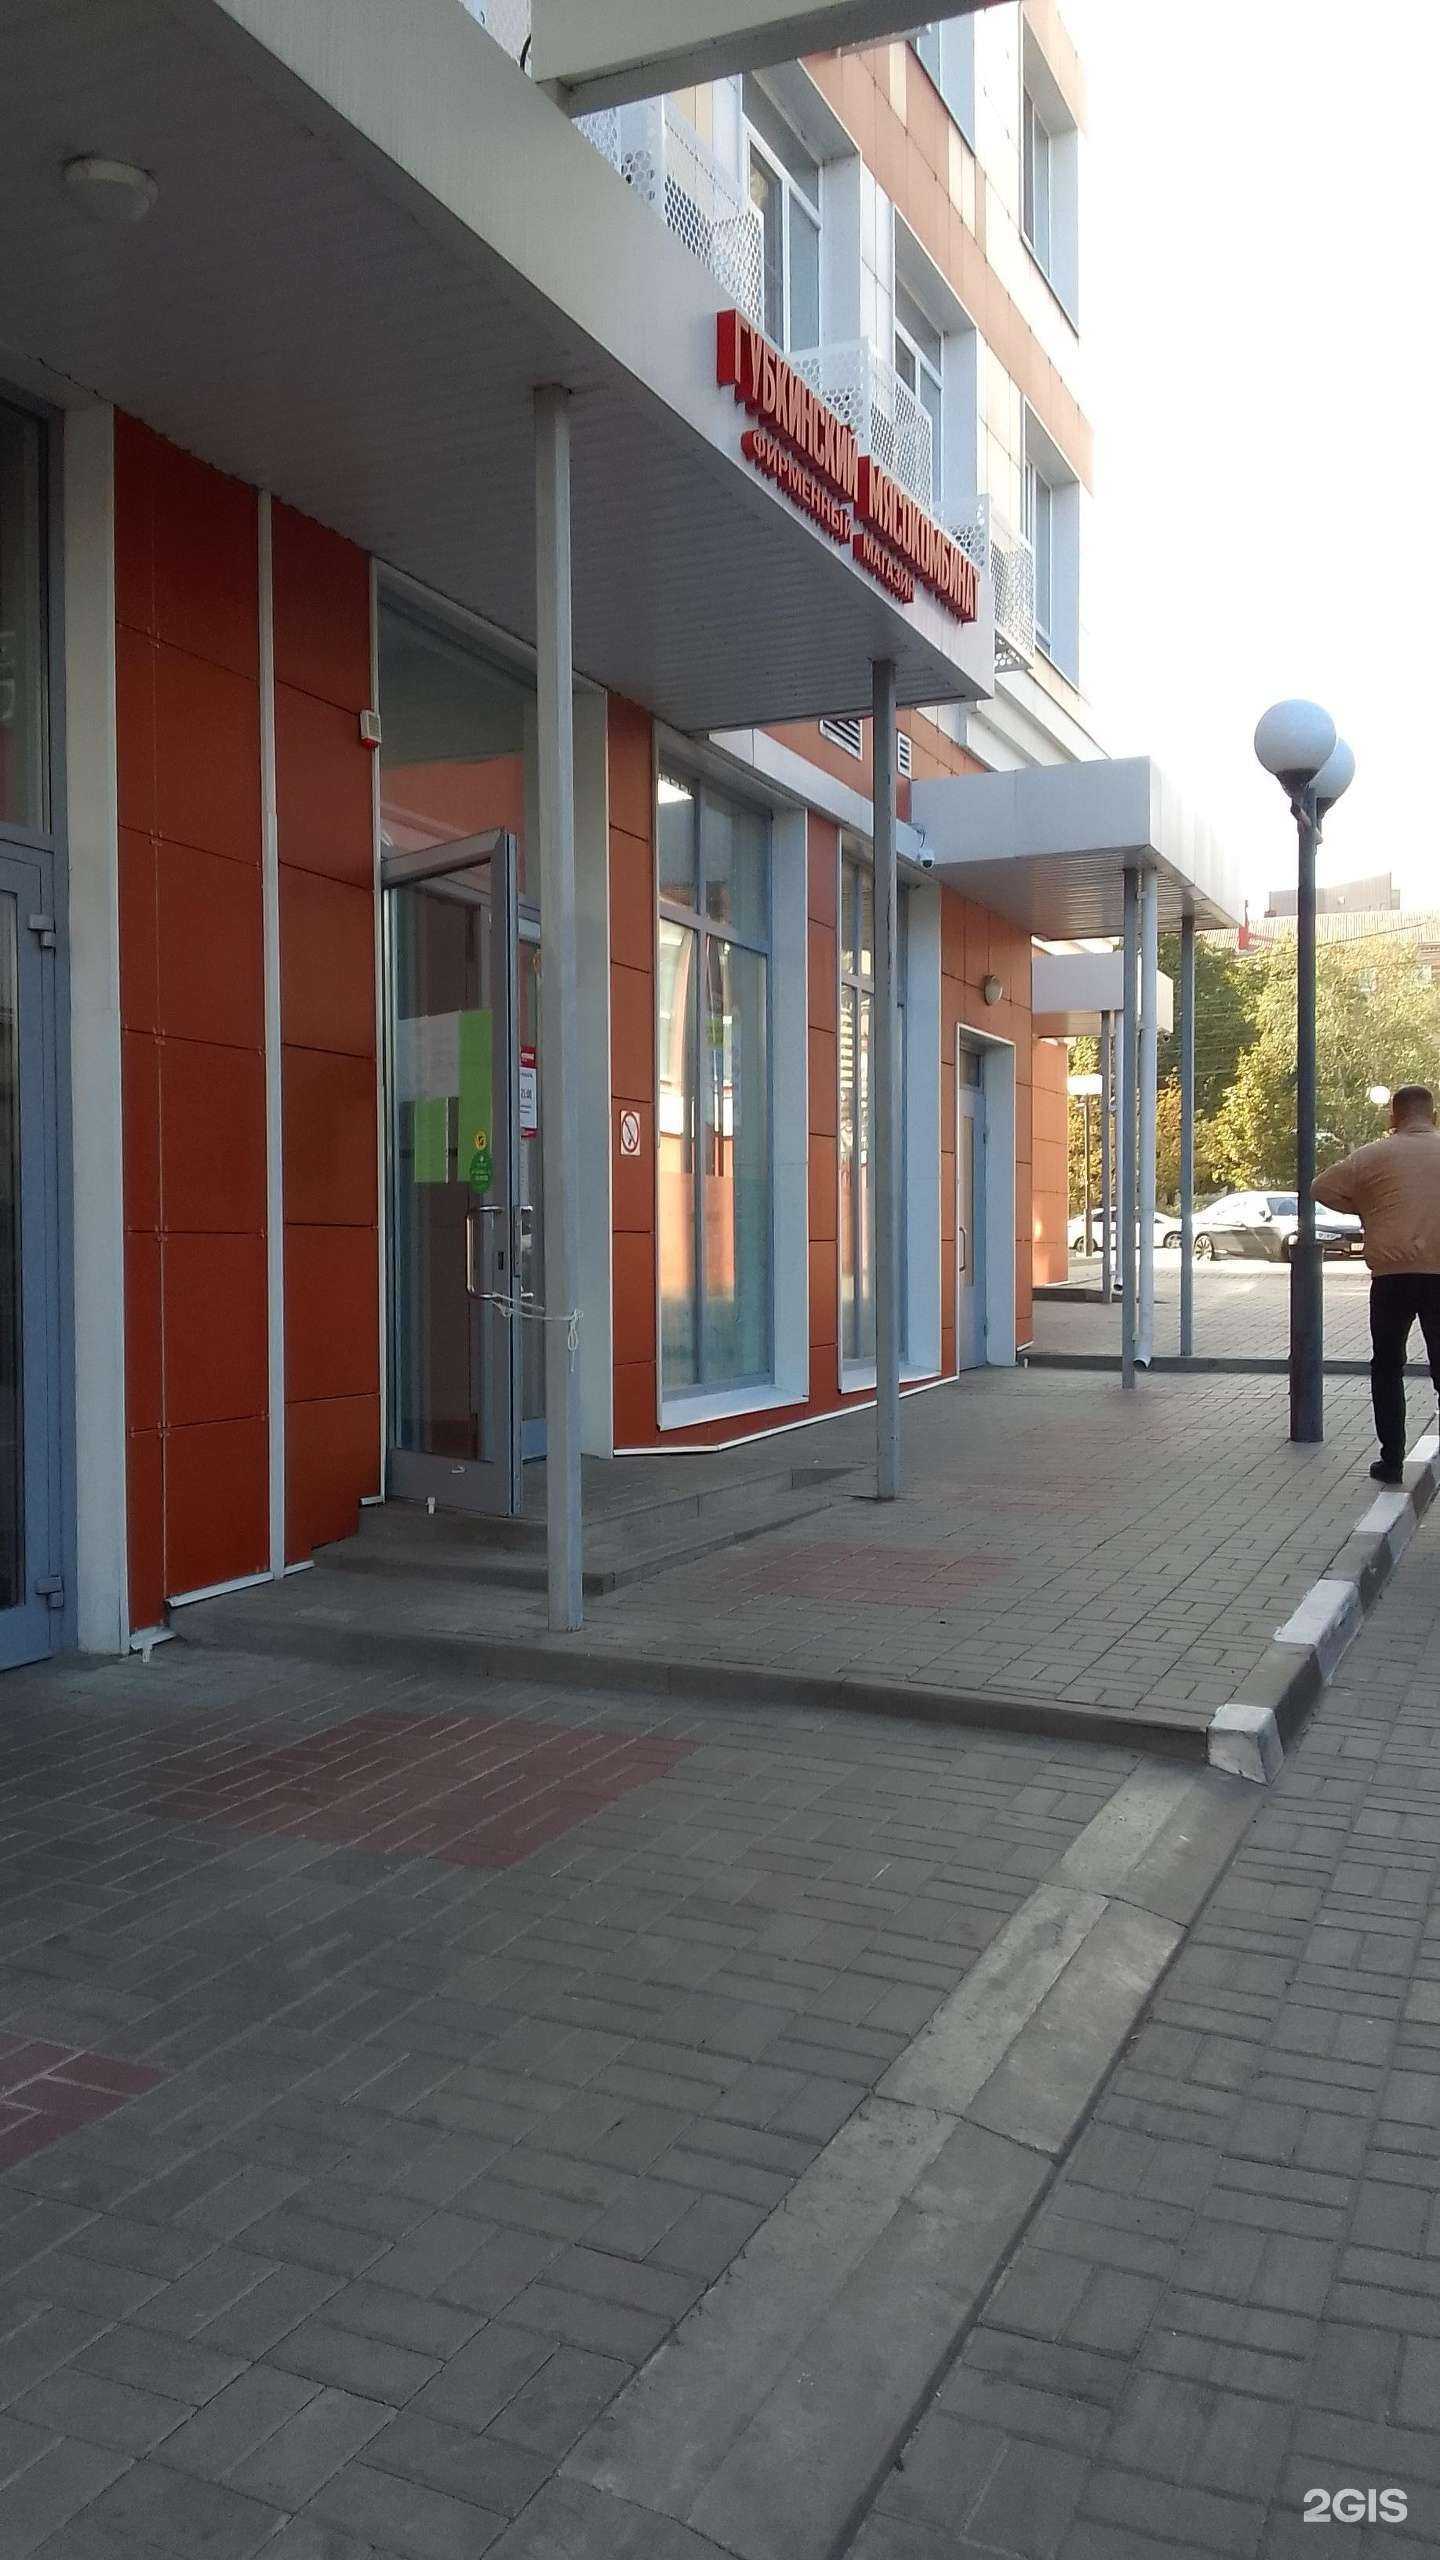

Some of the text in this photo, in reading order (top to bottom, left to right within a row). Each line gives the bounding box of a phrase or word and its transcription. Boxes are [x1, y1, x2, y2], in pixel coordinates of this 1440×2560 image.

[724, 309, 981, 621] ГУБКИНСКИЙ МЯСОКОМБИНАТ
[748, 431, 916, 602] ФИРМЕННЫЙ МАГАЗИН
